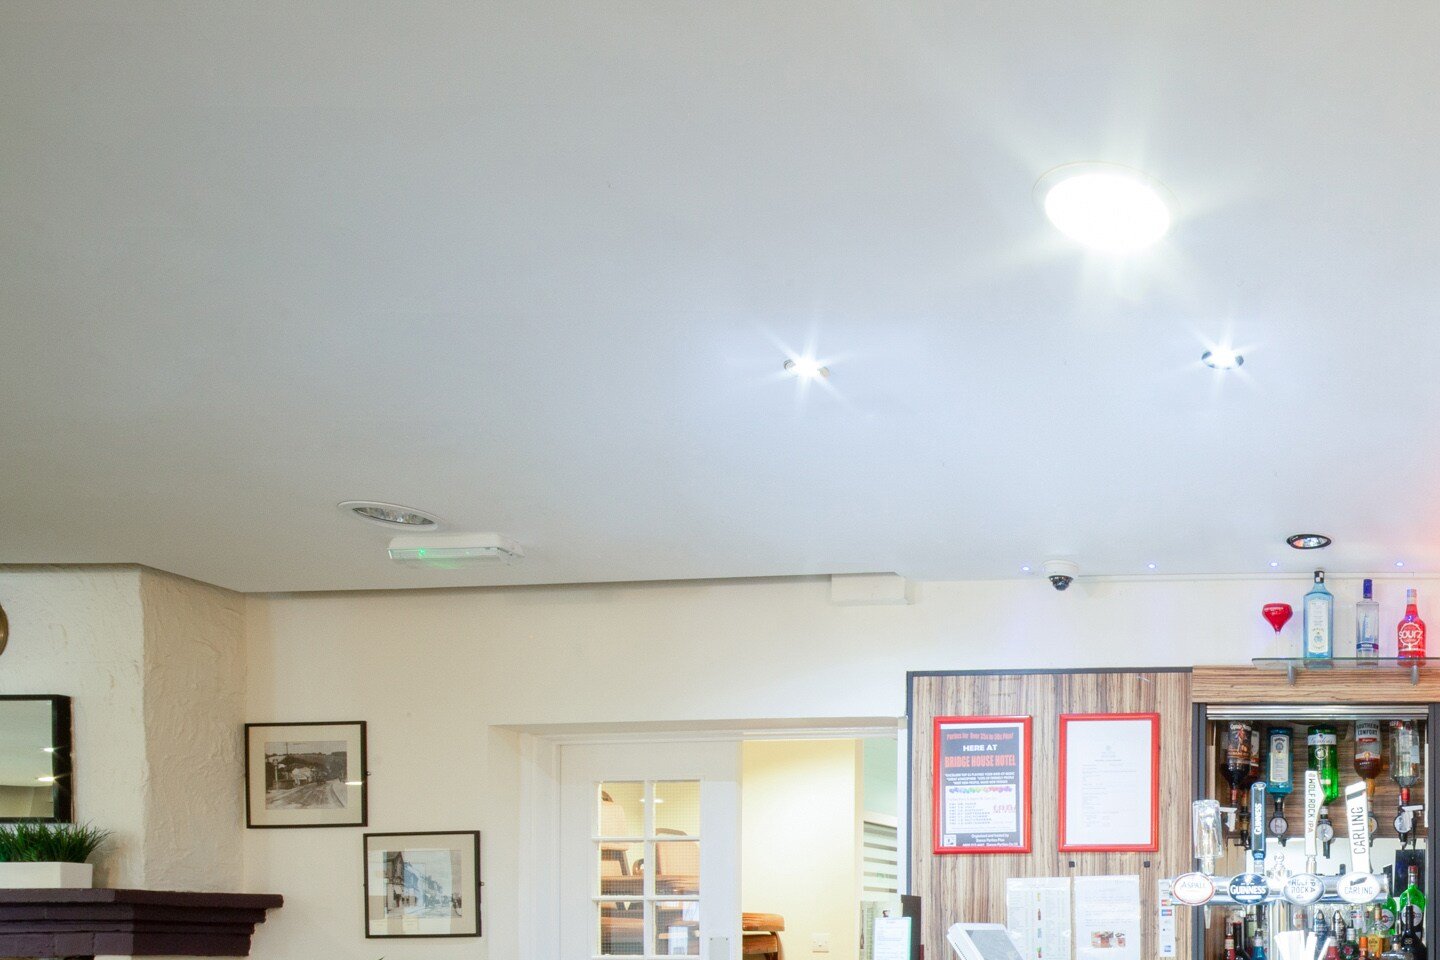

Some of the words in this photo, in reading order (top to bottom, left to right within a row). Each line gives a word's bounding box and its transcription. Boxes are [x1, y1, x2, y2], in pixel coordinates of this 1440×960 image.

[945, 756, 970, 768] BRIDGE
[971, 755, 994, 767] HOUSE
[995, 754, 1015, 767] HOTEL
[1308, 778, 1316, 797] WOLF
[1308, 799, 1316, 818] ROCK
[1254, 802, 1263, 835] GUINNESS
[1351, 806, 1366, 855] CARLING
[1230, 886, 1266, 894] GUINNESS
[1344, 886, 1373, 894] CARLING
